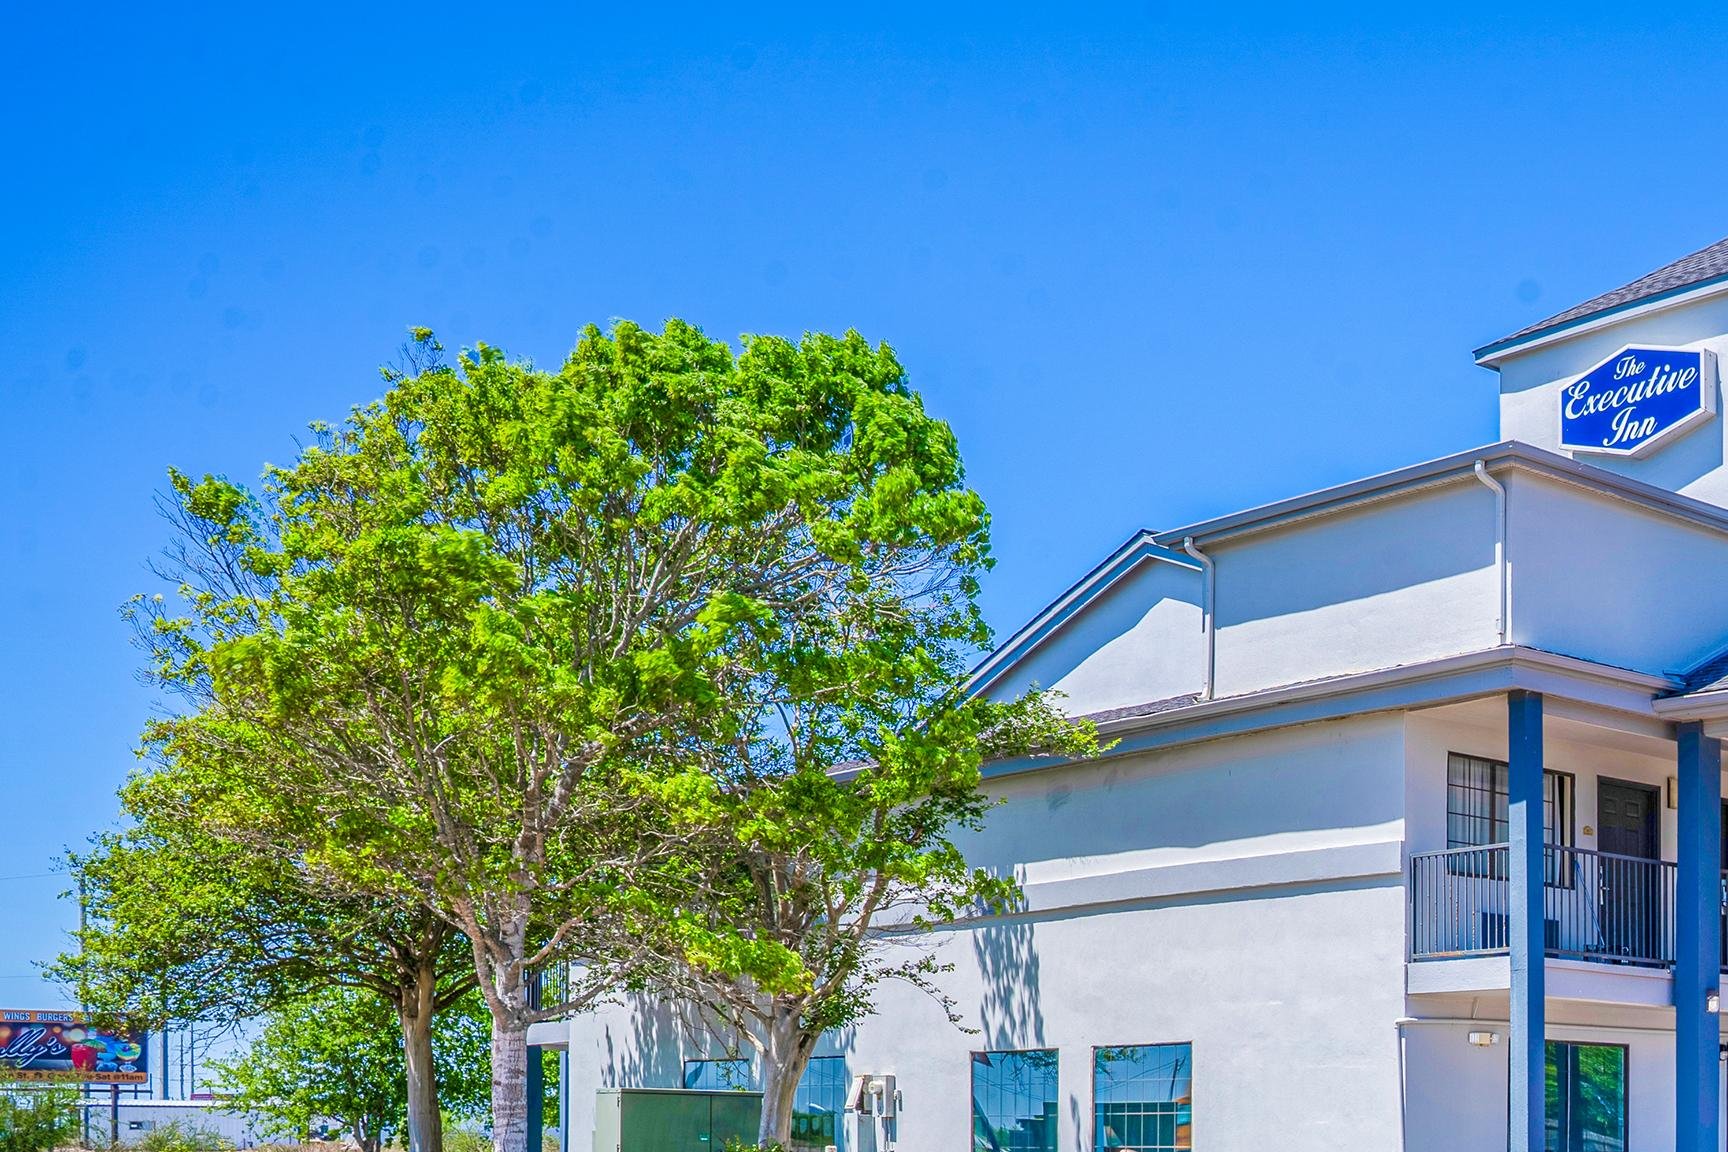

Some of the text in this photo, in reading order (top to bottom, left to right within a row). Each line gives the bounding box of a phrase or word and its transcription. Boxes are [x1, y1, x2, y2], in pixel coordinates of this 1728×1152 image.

[1613, 354, 1646, 380] The
[1565, 363, 1699, 420] Executive
[1602, 406, 1658, 447] Inn
[3, 1012, 30, 1021] WINGS
[36, 1012, 74, 1022] BURGERS
